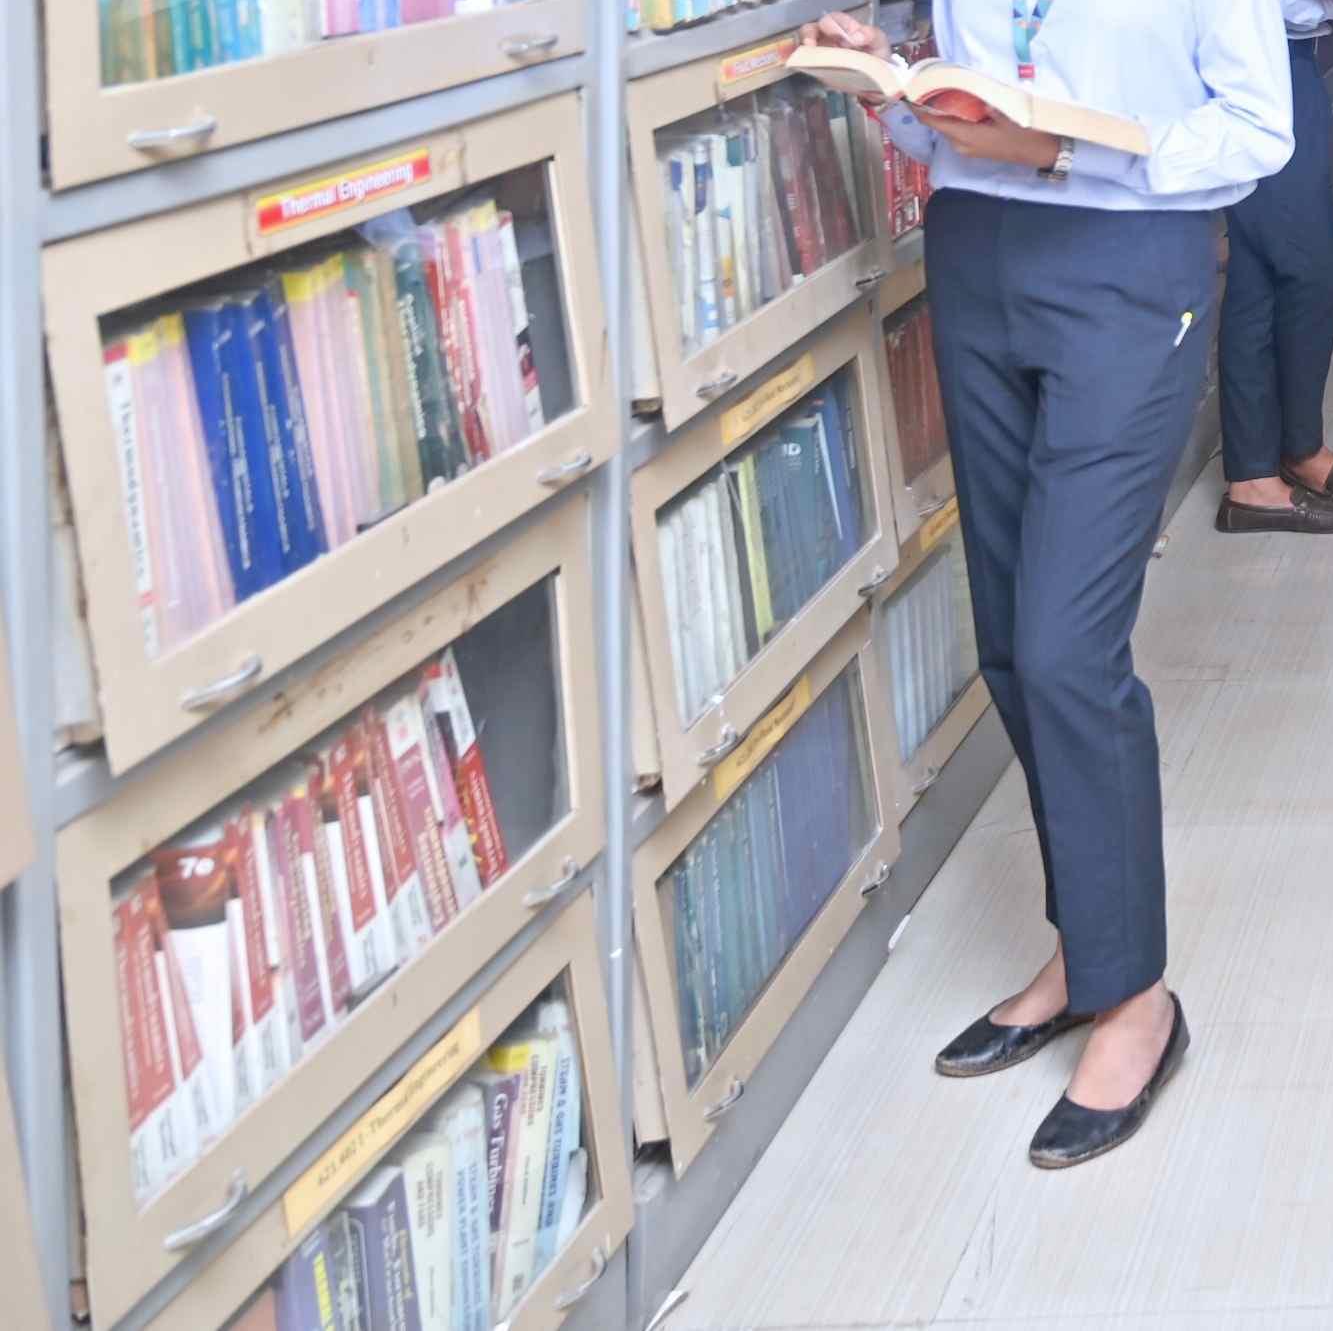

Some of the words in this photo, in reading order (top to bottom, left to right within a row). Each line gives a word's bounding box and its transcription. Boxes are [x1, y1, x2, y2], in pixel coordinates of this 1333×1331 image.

[281, 183, 338, 221] Thermal
[338, 163, 415, 204] Engineering
[494, 1092, 509, 1128] Gas
